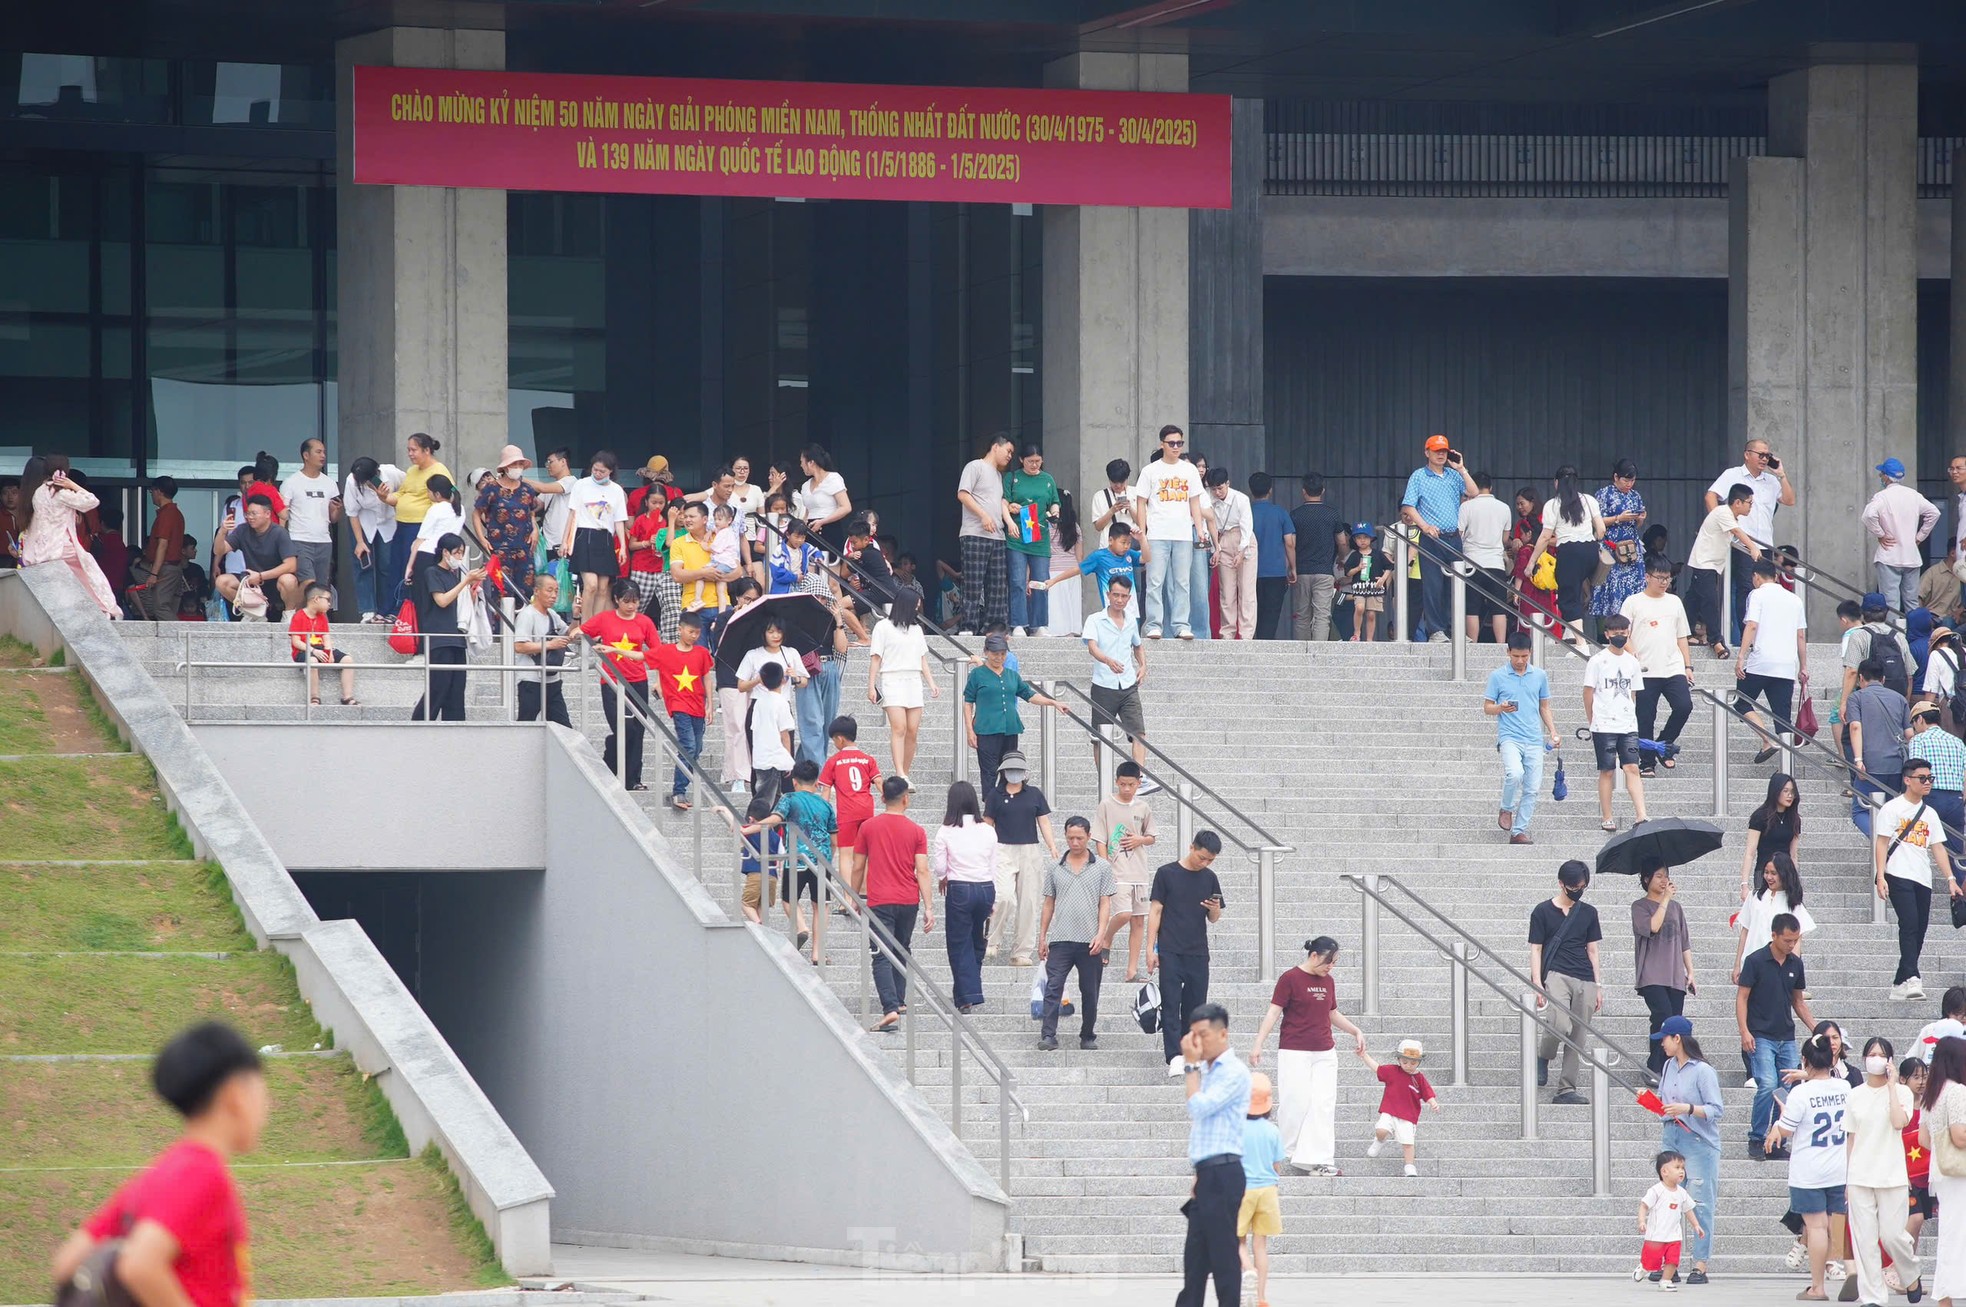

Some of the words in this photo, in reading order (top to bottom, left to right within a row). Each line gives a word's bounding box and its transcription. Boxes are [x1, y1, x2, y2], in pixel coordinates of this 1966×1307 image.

[392, 90, 433, 122] CHÀO
[438, 91, 485, 124] MỪNG
[490, 89, 509, 124] KỶ
[514, 94, 555, 132] NIỆM
[560, 101, 578, 128] 50
[583, 96, 618, 129] NĂM
[624, 97, 665, 130] NGÀY
[669, 96, 700, 131] GIẢI
[704, 101, 757, 133] PHÓNG
[761, 98, 801, 134] MIỀN
[805, 109, 846, 138] NAM,
[849, 100, 900, 137] THỐNG
[904, 102, 943, 139] NHẤT
[947, 103, 976, 139] ĐẤT
[980, 108, 1021, 141] NƯỚC
[1026, 115, 1104, 143] (30/4/1975
[1119, 117, 1197, 147] 30/4/2025)
[577, 136, 597, 169] VÀ
[602, 143, 629, 170] 139
[634, 138, 670, 170] NĂM
[675, 136, 716, 172] NGÀY
[719, 137, 761, 175] QUỐC
[765, 138, 784, 174] TẾ
[787, 148, 815, 175] LAO
[819, 144, 861, 181] ĐỘNG
[866, 151, 936, 179] (1/5/1886
[952, 153, 1020, 182] 1/5/2025)
[849, 766, 862, 792] 9
[1810, 1094, 1848, 1108] CEMMER
